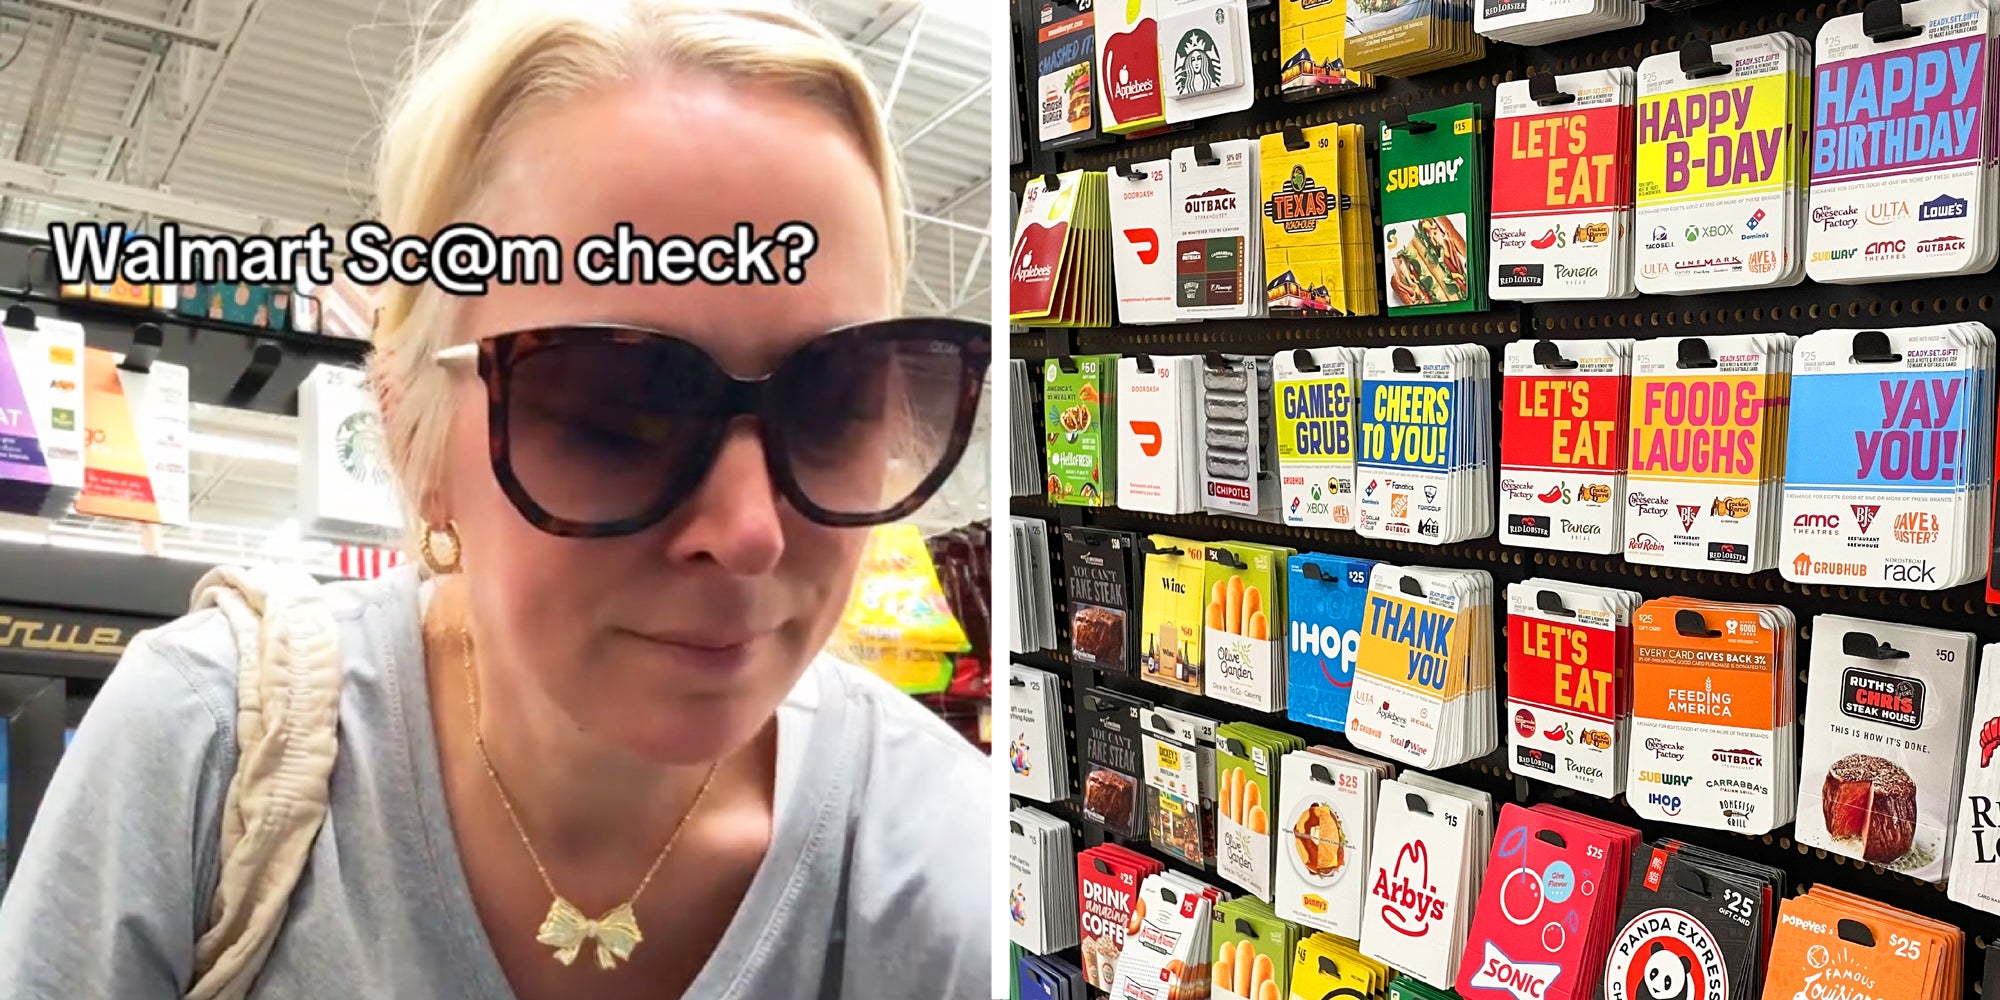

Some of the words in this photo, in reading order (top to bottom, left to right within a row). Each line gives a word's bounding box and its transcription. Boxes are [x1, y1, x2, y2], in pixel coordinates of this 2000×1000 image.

[1485, 7, 1498, 16] RED
[1498, 3, 1526, 12] LOBSTER
[1825, 36, 1840, 48] $25
[1817, 42, 1981, 126] HAPPY
[1639, 85, 1754, 145] HAPPY
[1512, 115, 1587, 160] LET'S
[1814, 107, 1976, 174] BIRTHDAY
[1666, 127, 1783, 193] B-DAY
[1151, 170, 1163, 182] $25
[1386, 157, 1463, 192] SUBWAY
[1546, 154, 1614, 205] EAT
[1185, 198, 1236, 213] OUTBACK
[1274, 193, 1327, 220] TEXAS
[1871, 201, 1909, 218] ULTA
[1923, 203, 1962, 218] LOWE'S
[1701, 224, 1734, 238] XBOX
[1824, 217, 1857, 232] Factory
[1810, 248, 1858, 262] SUBWAY
[1917, 242, 1965, 253] OUTBACK
[1865, 254, 1906, 262] THEATRES
[1554, 264, 1598, 280] Panera
[1644, 263, 1669, 274] ULTA
[1801, 351, 1816, 361] $25
[1082, 362, 1095, 373] $60
[1158, 368, 1169, 378] $50
[1374, 385, 1450, 425] CHEERS
[1519, 381, 1589, 418] LET'S
[1879, 379, 1961, 429] YAY
[1296, 420, 1349, 455] GRUB
[1362, 423, 1385, 460] TO
[1391, 425, 1447, 465] YOU!
[1552, 420, 1614, 465] EAT
[1631, 428, 1755, 475] LAUGHS
[1855, 431, 1958, 480] YOU!
[1216, 485, 1249, 499] CHIPOTLE
[1392, 482, 1414, 490] Fanatics
[1307, 503, 1328, 514] XBOX
[1638, 504, 1668, 517] Factory
[1560, 519, 1601, 535] Panera
[1628, 537, 1642, 549] Red
[1643, 539, 1664, 551] Robin
[1188, 547, 1202, 560] $60
[1349, 571, 1364, 583] $25
[1813, 561, 1867, 576] GRUBHUB
[1884, 559, 1936, 583] rack
[1070, 577, 1092, 600] FAKE
[1093, 580, 1123, 605] STEAK
[1162, 577, 1186, 594] Winc
[1371, 597, 1454, 657] THANK
[1638, 614, 1653, 624] $25
[1291, 620, 1361, 674] IHOP
[1523, 621, 1587, 665] LET'S
[1217, 647, 1240, 665] Olive
[1639, 648, 1667, 657] EVERY
[1669, 650, 1694, 660] CARD
[1696, 652, 1724, 661] GIVES
[1726, 654, 1752, 663] BACK
[1754, 655, 1766, 665] 3%
[1936, 649, 1955, 662] $50
[1220, 660, 1254, 680] Garden
[1407, 650, 1447, 690] YOU
[1555, 663, 1612, 714] EAT
[1850, 676, 1895, 693] RUTH'S
[1668, 689, 1732, 704] FEEDING
[1668, 702, 1732, 717] AMERICA
[1846, 703, 1878, 717] STEAK
[1881, 709, 1916, 725] HOUSE
[1390, 734, 1404, 747] Total
[1410, 742, 1427, 755] Wine
[1830, 724, 1849, 735] THIS
[1852, 728, 1860, 738] IS
[1864, 731, 1883, 743] HOW
[1886, 737, 1901, 747] IT'S
[1904, 740, 1930, 754] DONE.
[1088, 738, 1107, 764] FAKE
[1109, 746, 1136, 773] STEAK
[1656, 749, 1684, 761] Factory
[1711, 753, 1763, 767] OUTBACK
[1565, 757, 1603, 778] Panera
[1338, 773, 1358, 788] $25
[1638, 770, 1693, 787] SUBWAY
[1706, 779, 1768, 795] CARRABBA'S
[1648, 793, 1681, 811] IHOP
[1719, 800, 1755, 813] BONEFISH
[1445, 813, 1457, 827] $15
[1727, 818, 1746, 828] GRILL
[1227, 848, 1253, 872] Garden
[1586, 845, 1603, 859] $25
[1120, 872, 1133, 886] $25
[1552, 872, 1565, 880] Give
[1083, 879, 1130, 913] DRINK
[1304, 894, 1328, 911] Denny's
[1373, 868, 1445, 922] Arby's
[1723, 888, 1754, 918] $25
[1086, 900, 1129, 927] amazing
[1719, 907, 1733, 919] GIFT
[1733, 913, 1750, 927] CARD
[1889, 933, 1921, 960] $25
[1620, 917, 1671, 956] PANDA
[1677, 920, 1720, 1000] EXPRESS
[1483, 958, 1544, 998] SONIC
[1825, 968, 1875, 989] FAMOUS
